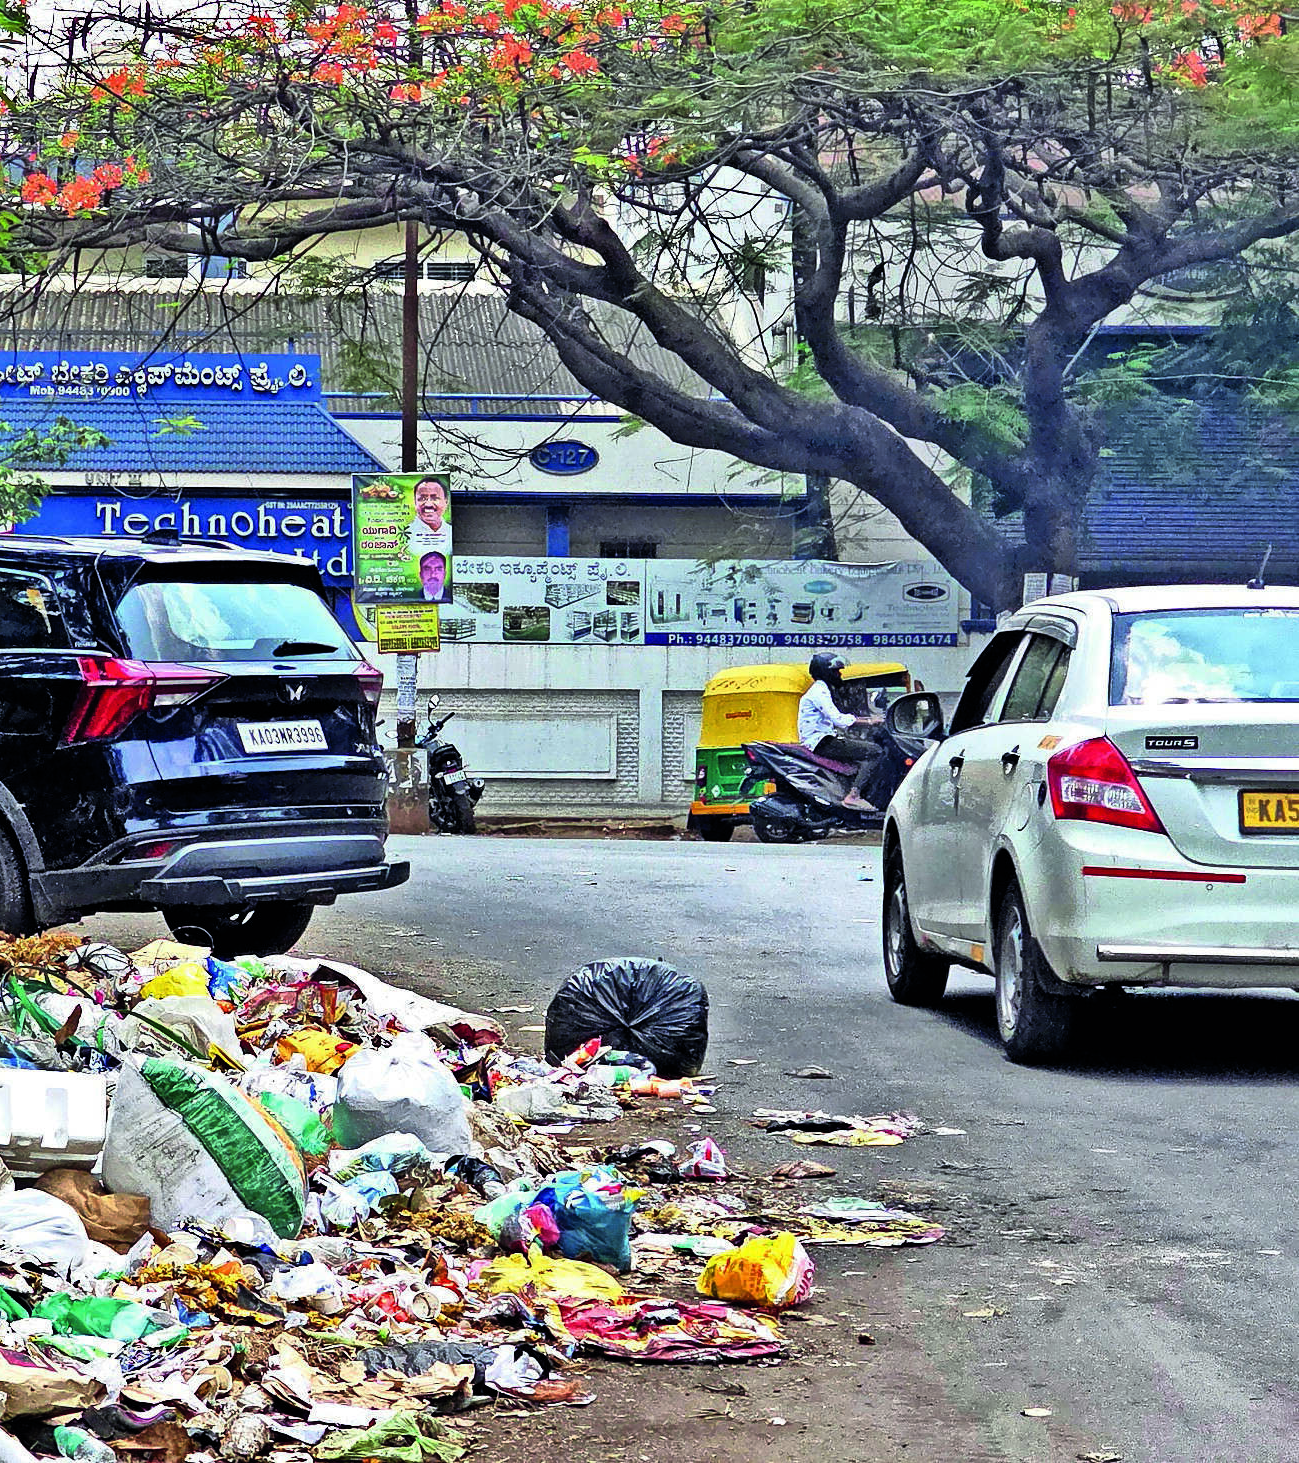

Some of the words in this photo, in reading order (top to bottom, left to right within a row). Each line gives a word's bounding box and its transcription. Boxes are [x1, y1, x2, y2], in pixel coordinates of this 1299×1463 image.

[537, 447, 589, 464] C-127
[96, 501, 350, 538] Technoheat
[294, 546, 355, 576] td.
[456, 560, 495, 575] ಬೇಕರಿ
[696, 634, 777, 646] 9448370900,
[873, 634, 951, 645] 9845041474
